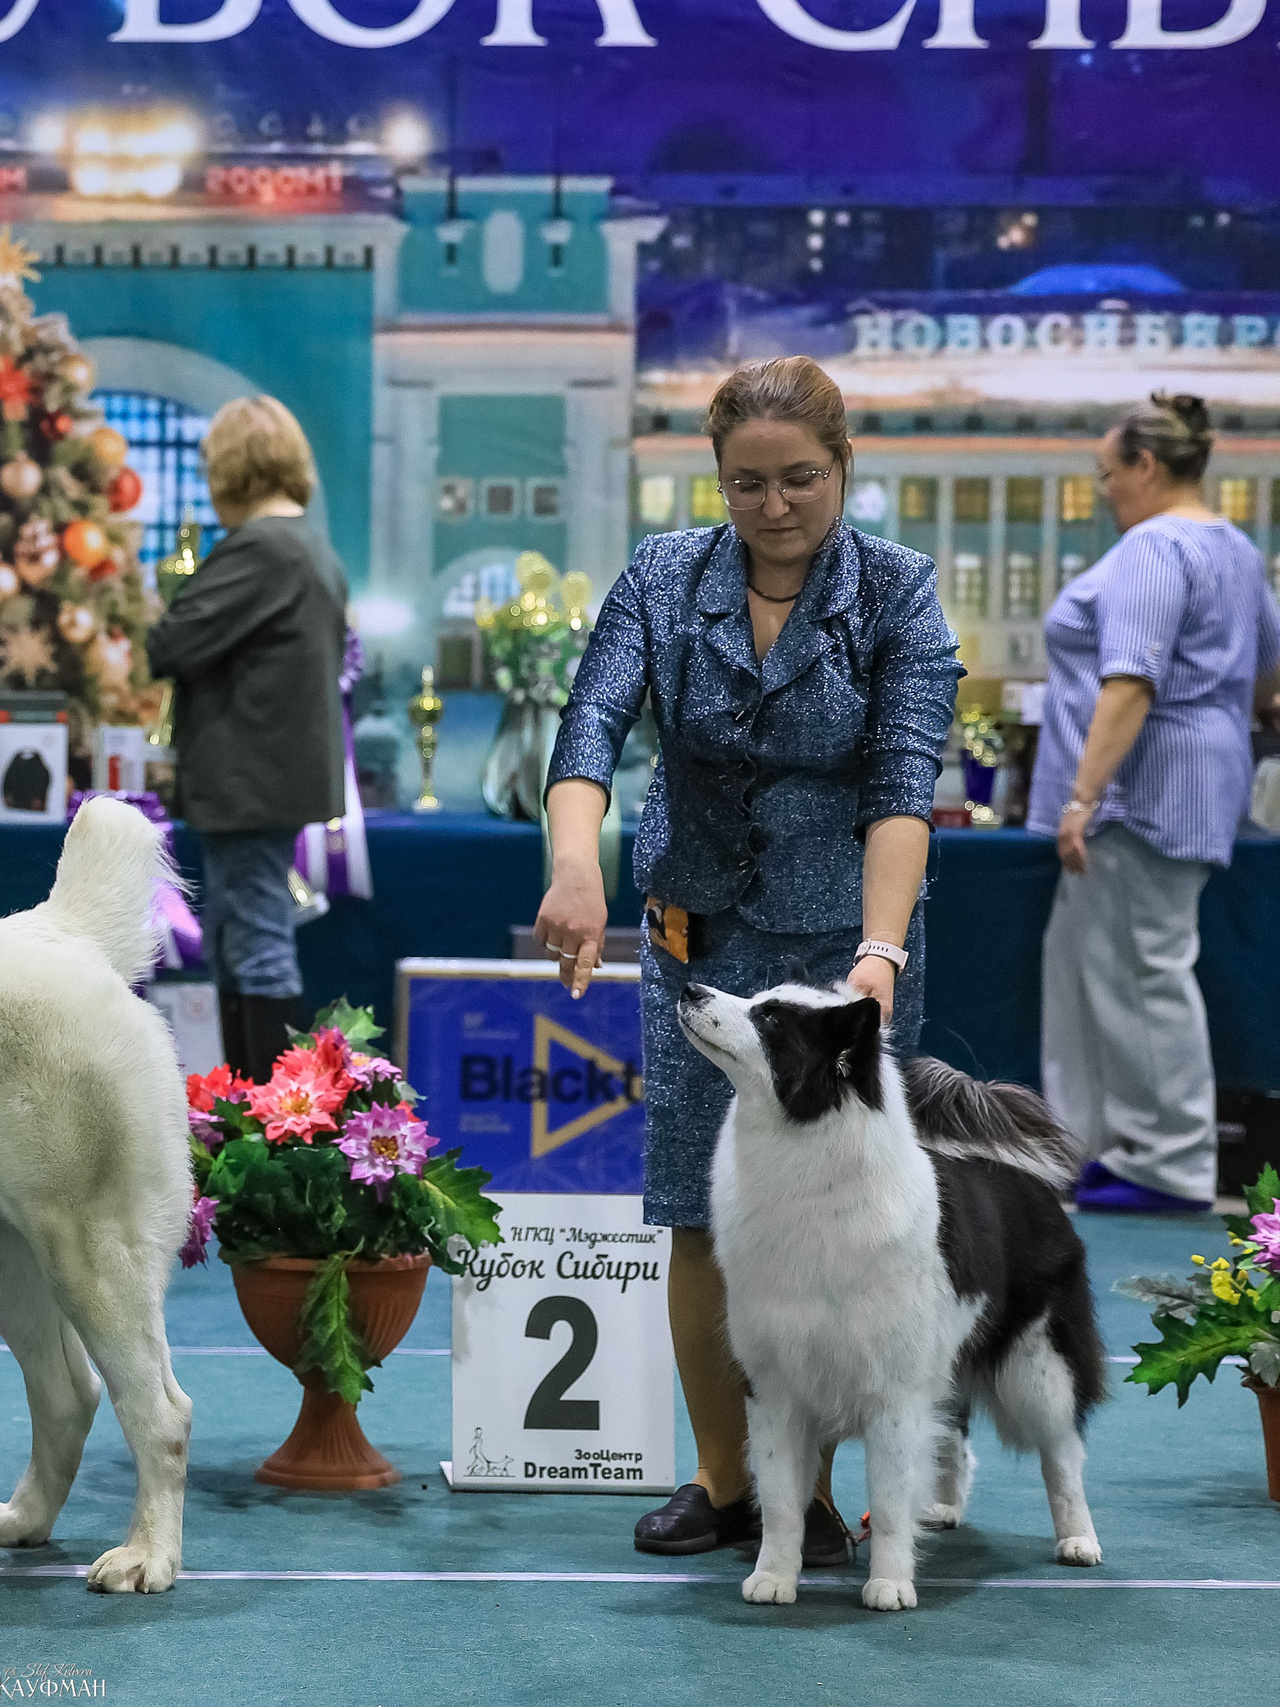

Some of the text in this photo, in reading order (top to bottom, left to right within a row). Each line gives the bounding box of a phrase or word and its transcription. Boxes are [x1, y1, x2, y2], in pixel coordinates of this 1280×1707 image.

[853, 311, 1280, 357] НОВОСИБИР
[510, 1227, 554, 1246] НГКЦ
[457, 1249, 660, 1294] Кубок Сибири
[523, 1296, 600, 1431] 2
[524, 1461, 644, 1481] DreamTeam
[575, 1448, 643, 1464] ЗооЦентр
